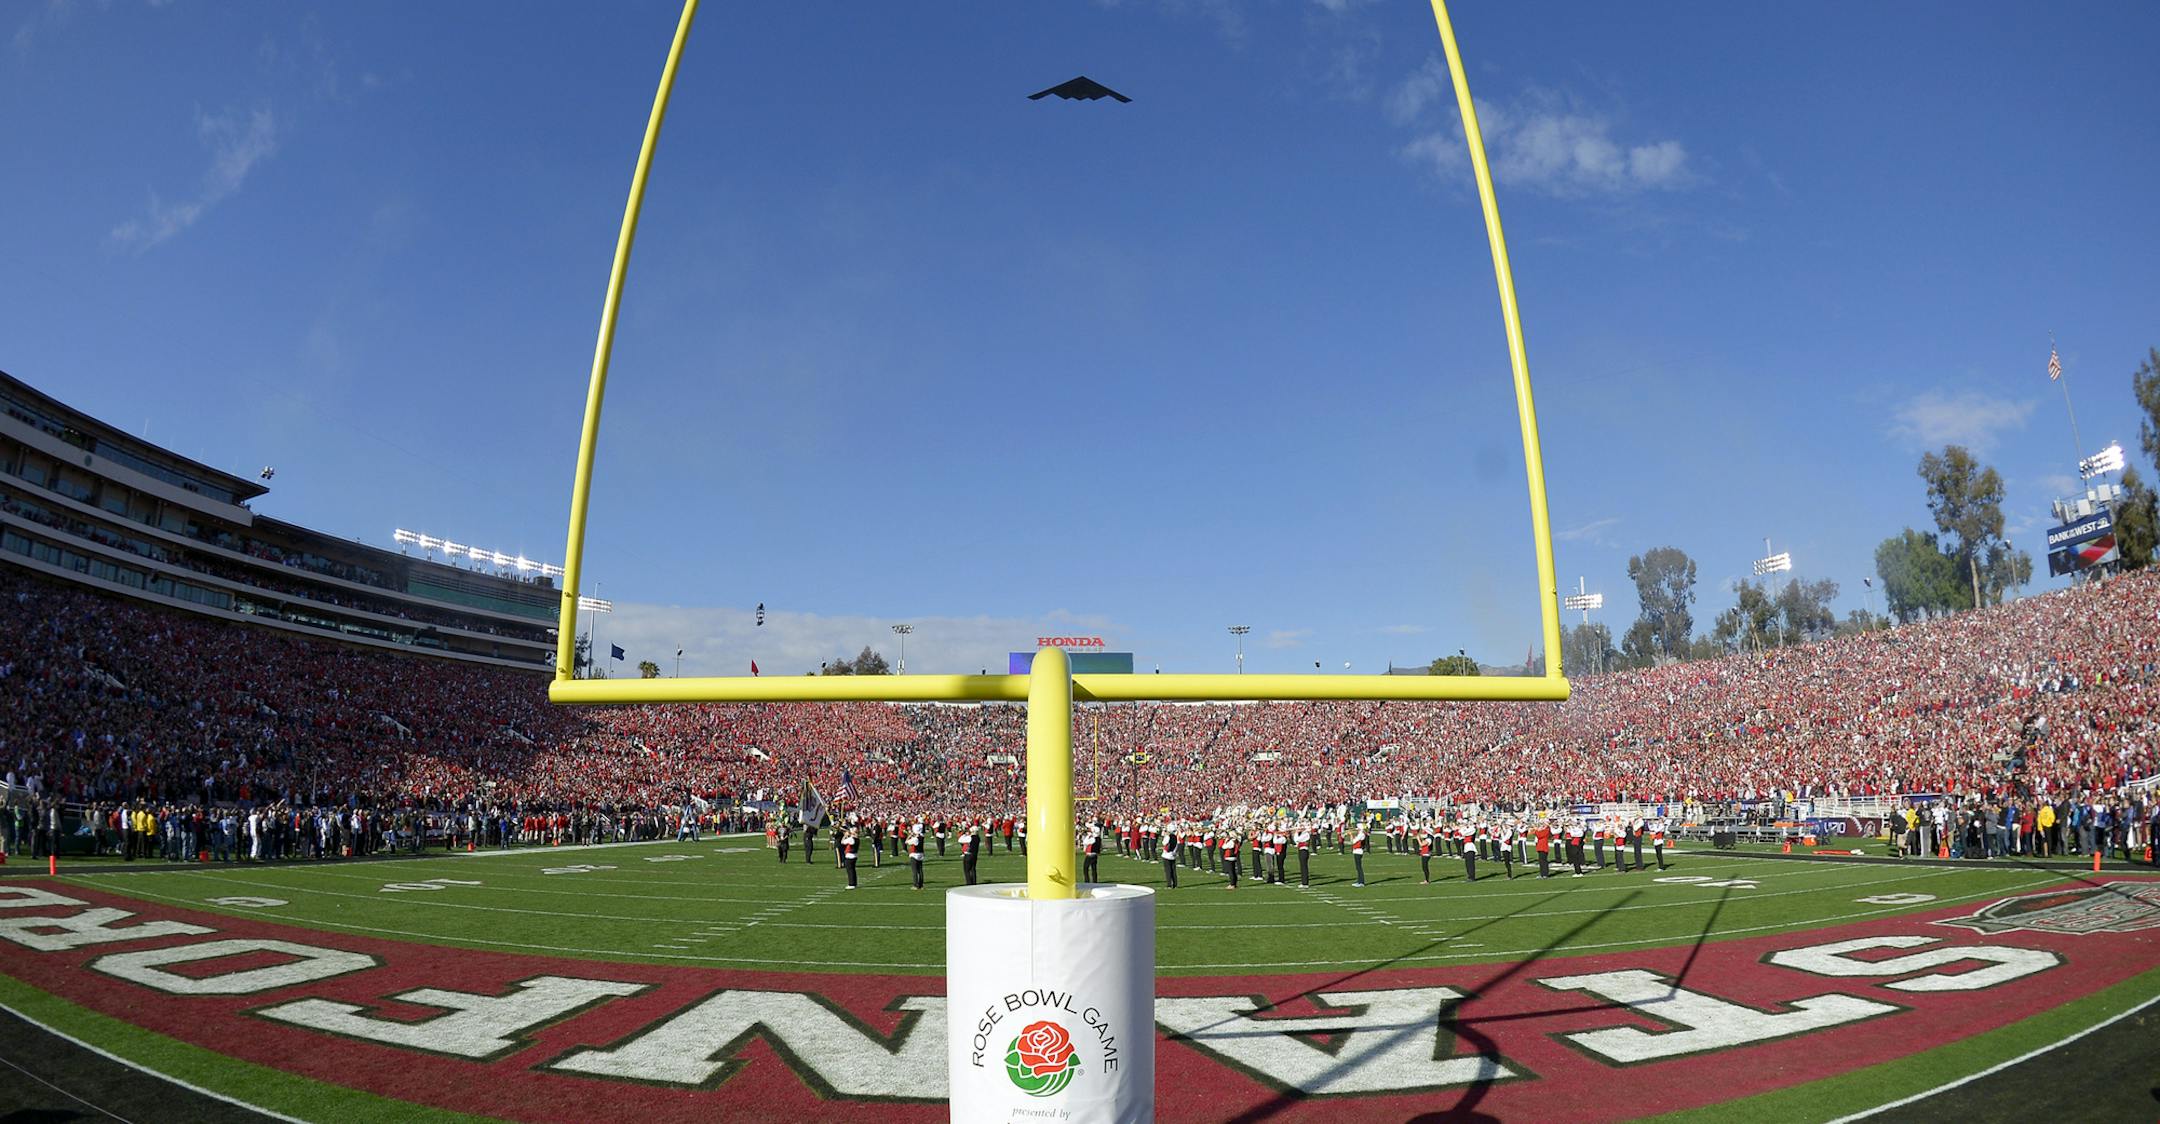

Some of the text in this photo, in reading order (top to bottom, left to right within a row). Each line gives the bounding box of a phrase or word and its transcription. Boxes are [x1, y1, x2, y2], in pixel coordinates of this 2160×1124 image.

[2048, 530, 2070, 545] BANK
[2075, 521, 2097, 536] WEST
[1037, 637, 1105, 647] HONDA
[972, 988, 1119, 1074] ROSE BOWL GAME
[1012, 1107, 1071, 1120] presented by
